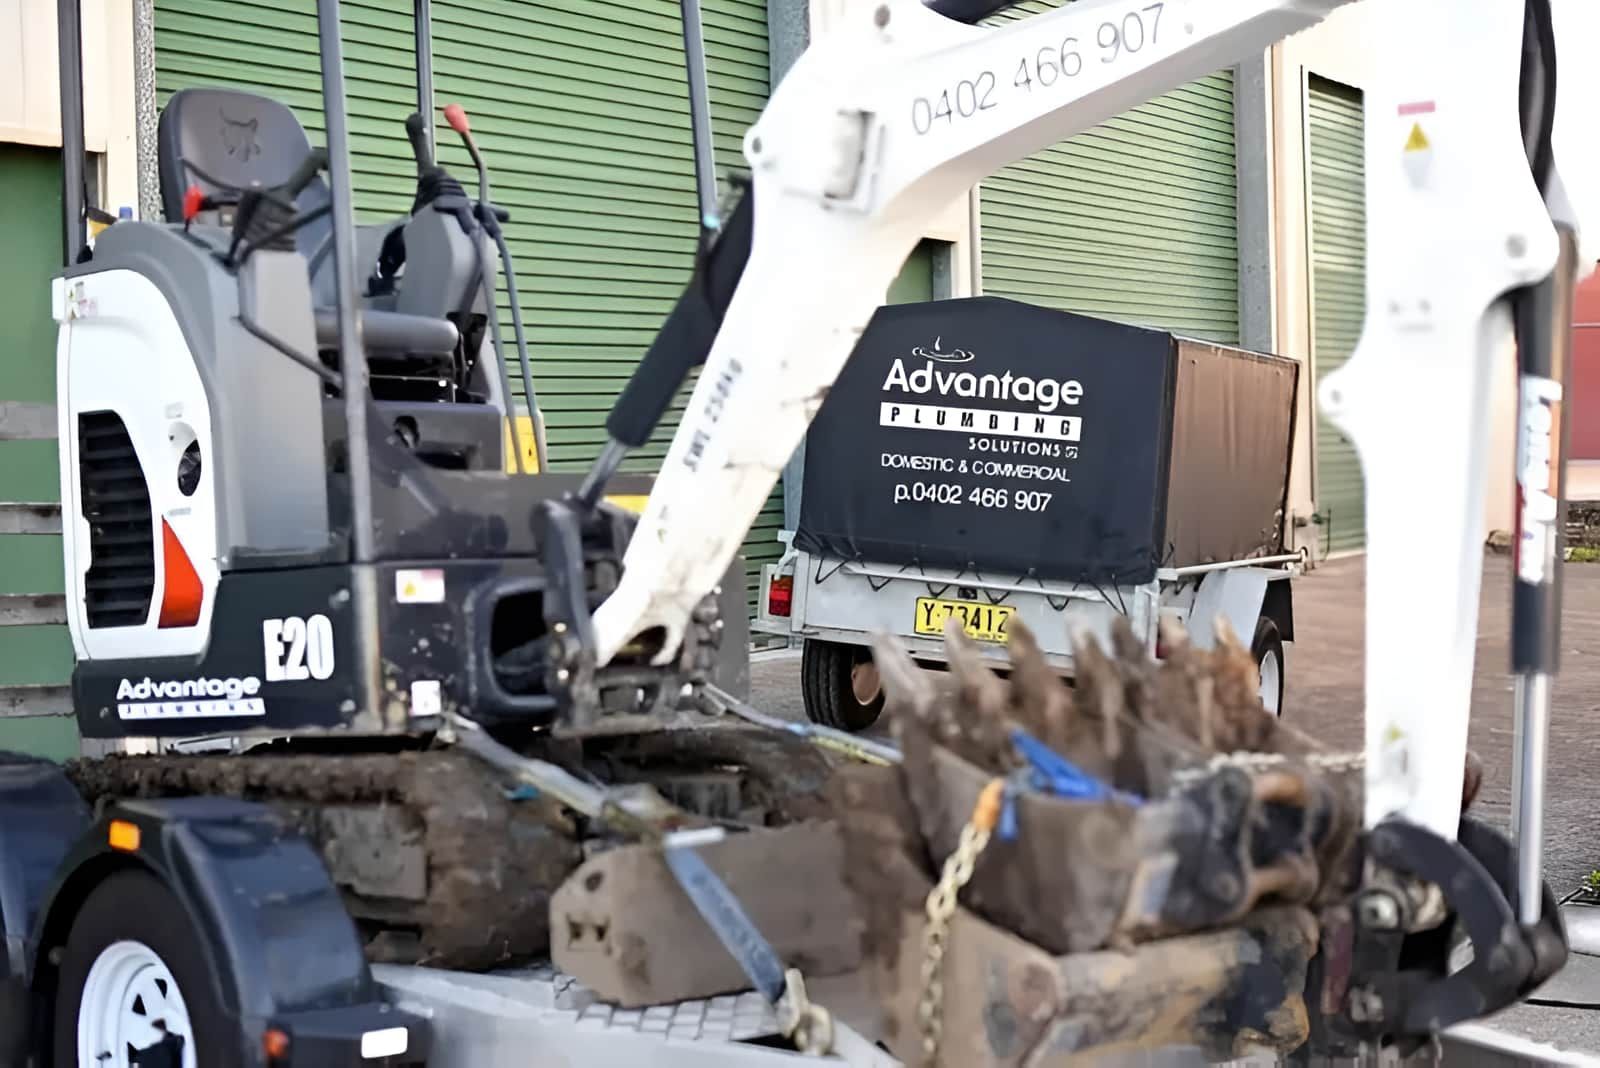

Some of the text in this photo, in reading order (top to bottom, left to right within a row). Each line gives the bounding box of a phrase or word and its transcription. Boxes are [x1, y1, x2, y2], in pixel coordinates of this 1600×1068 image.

[912, 2, 1165, 135] 0402 466 907
[882, 358, 1084, 412] Advantage
[890, 406, 1071, 436] PLUMBING
[968, 437, 1060, 458] SOLUTIONS
[881, 453, 1071, 482] DOMESTIC & COMMERCIAL
[969, 487, 1008, 508] 466
[1014, 490, 1052, 512] 907
[263, 614, 335, 682] E20
[116, 676, 261, 700] Advantage
